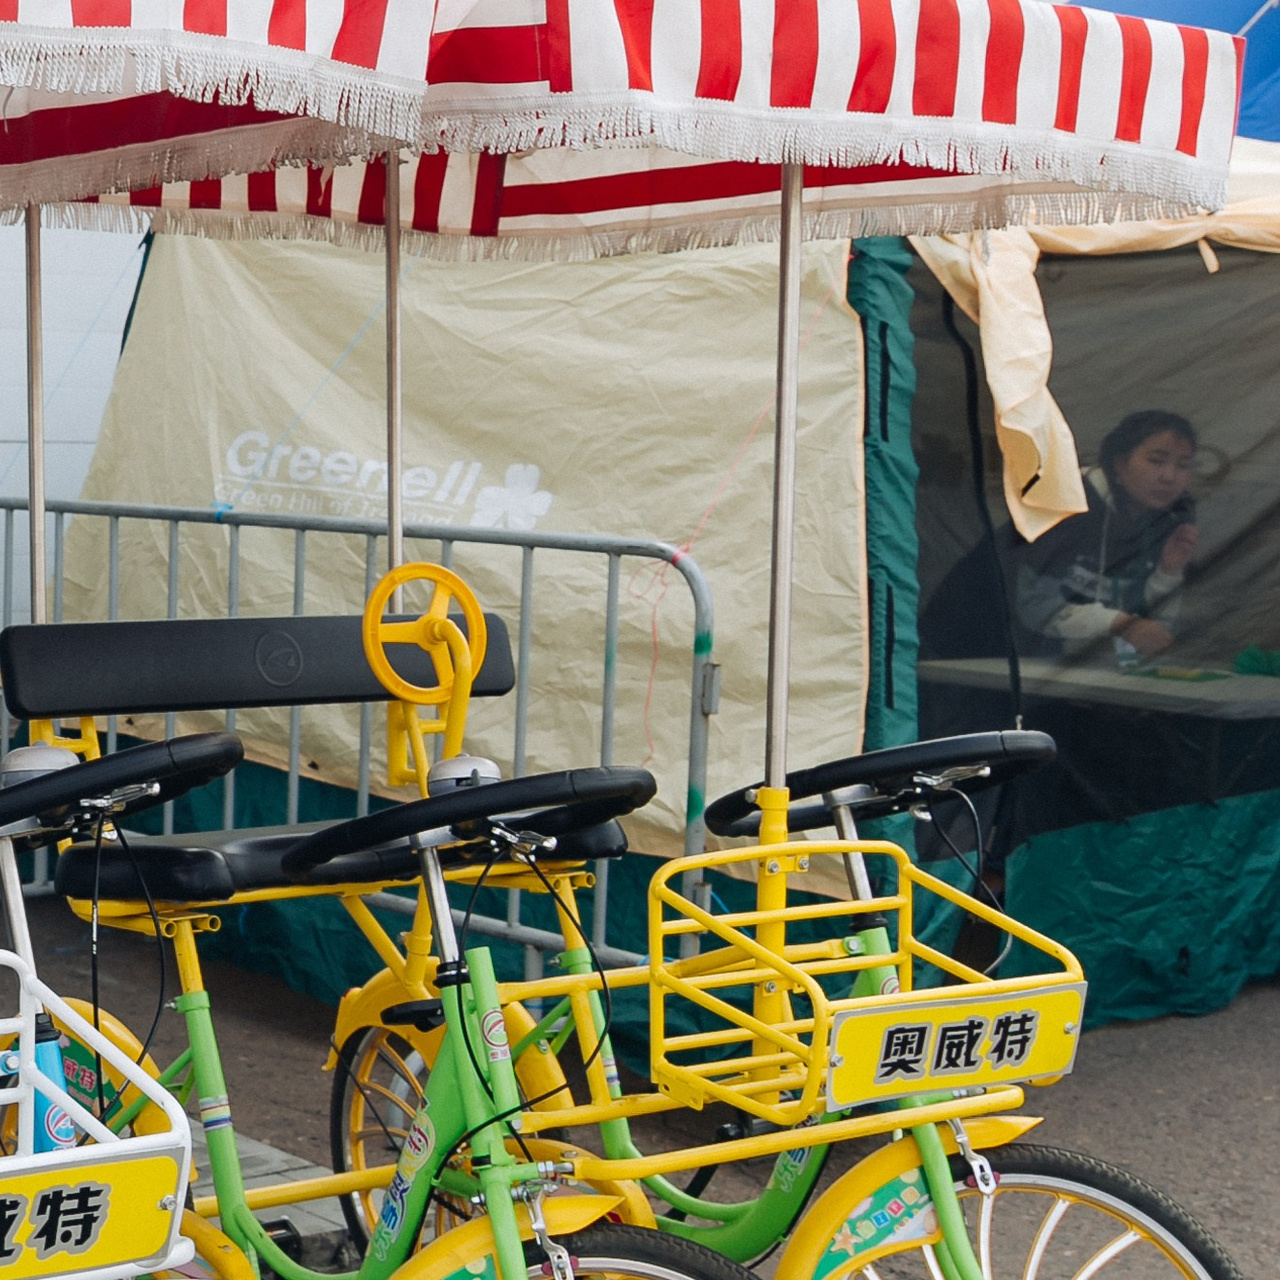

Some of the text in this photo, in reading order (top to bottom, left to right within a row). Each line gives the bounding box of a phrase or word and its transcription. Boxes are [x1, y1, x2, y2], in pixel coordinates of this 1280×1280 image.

[226, 430, 483, 505] Greenell
[878, 1012, 1036, 1079] 奥威特
